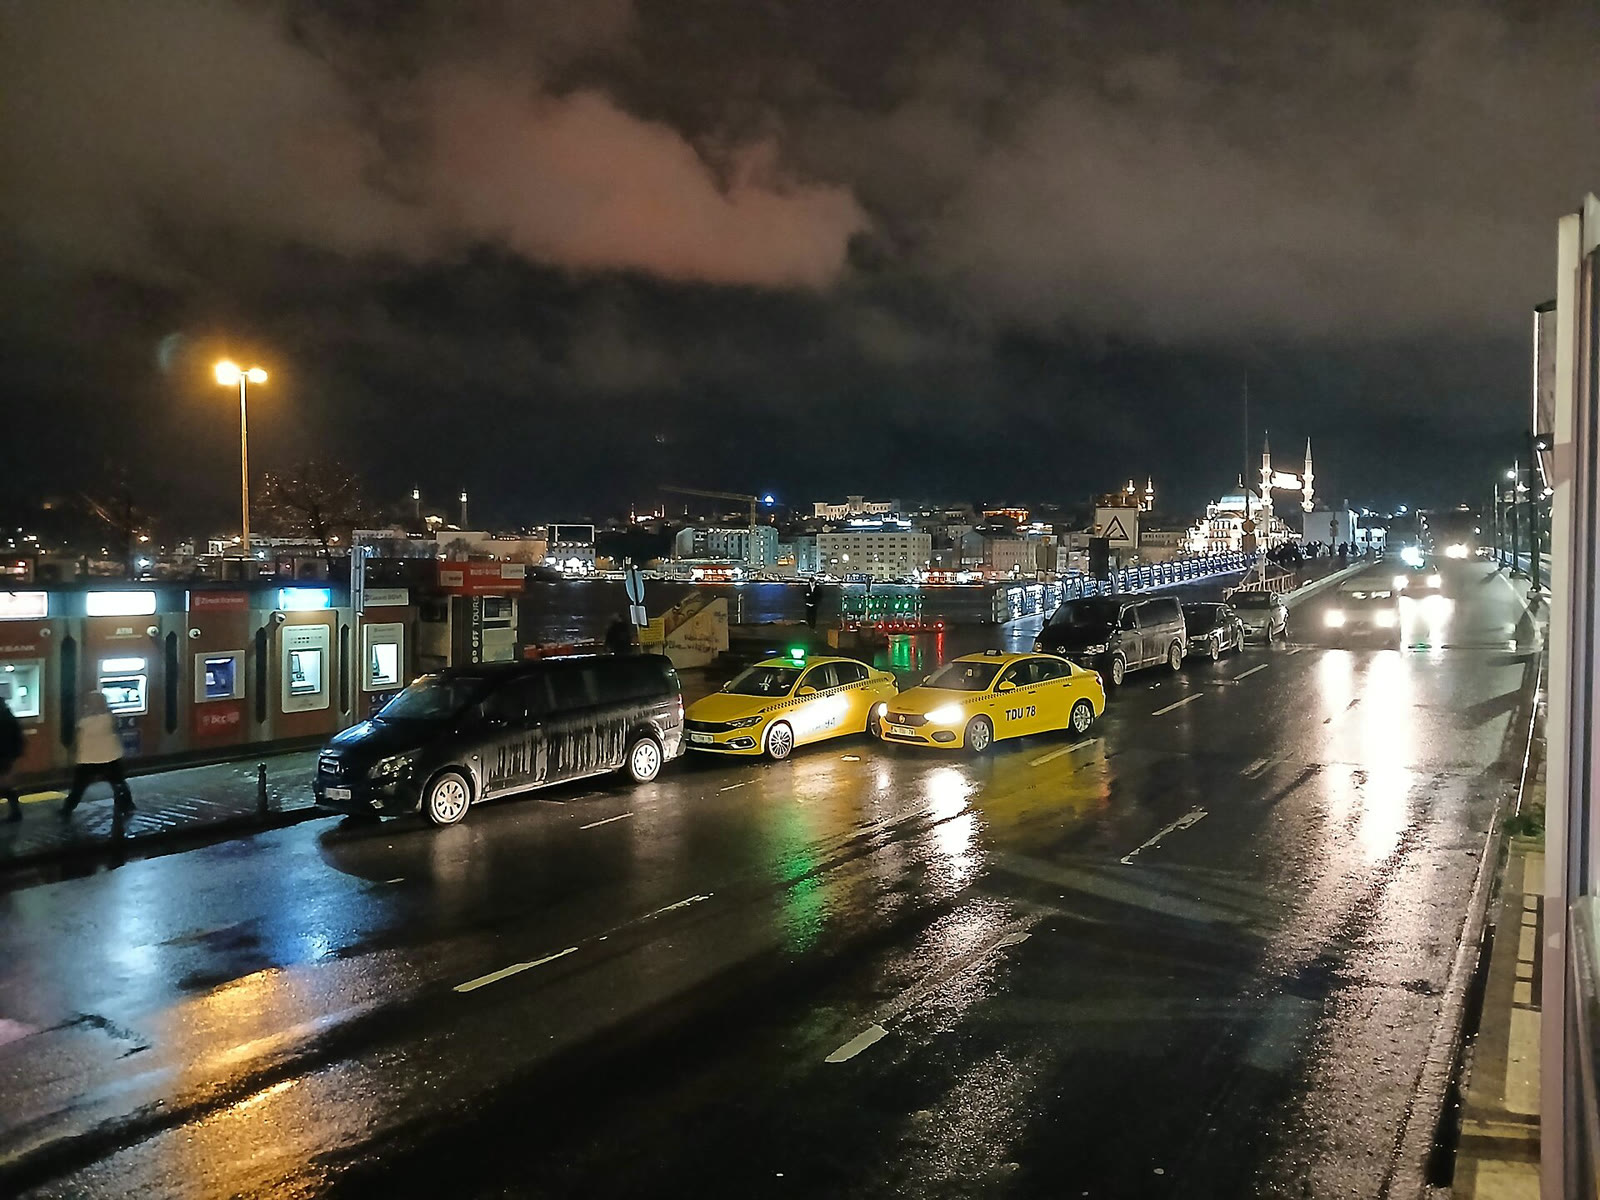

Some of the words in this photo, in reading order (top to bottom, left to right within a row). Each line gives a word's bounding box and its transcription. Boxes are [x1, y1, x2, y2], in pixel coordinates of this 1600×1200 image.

[472, 595, 480, 626] TOURS
[1005, 707, 1024, 722] TDU
[1025, 705, 1036, 718] 78
